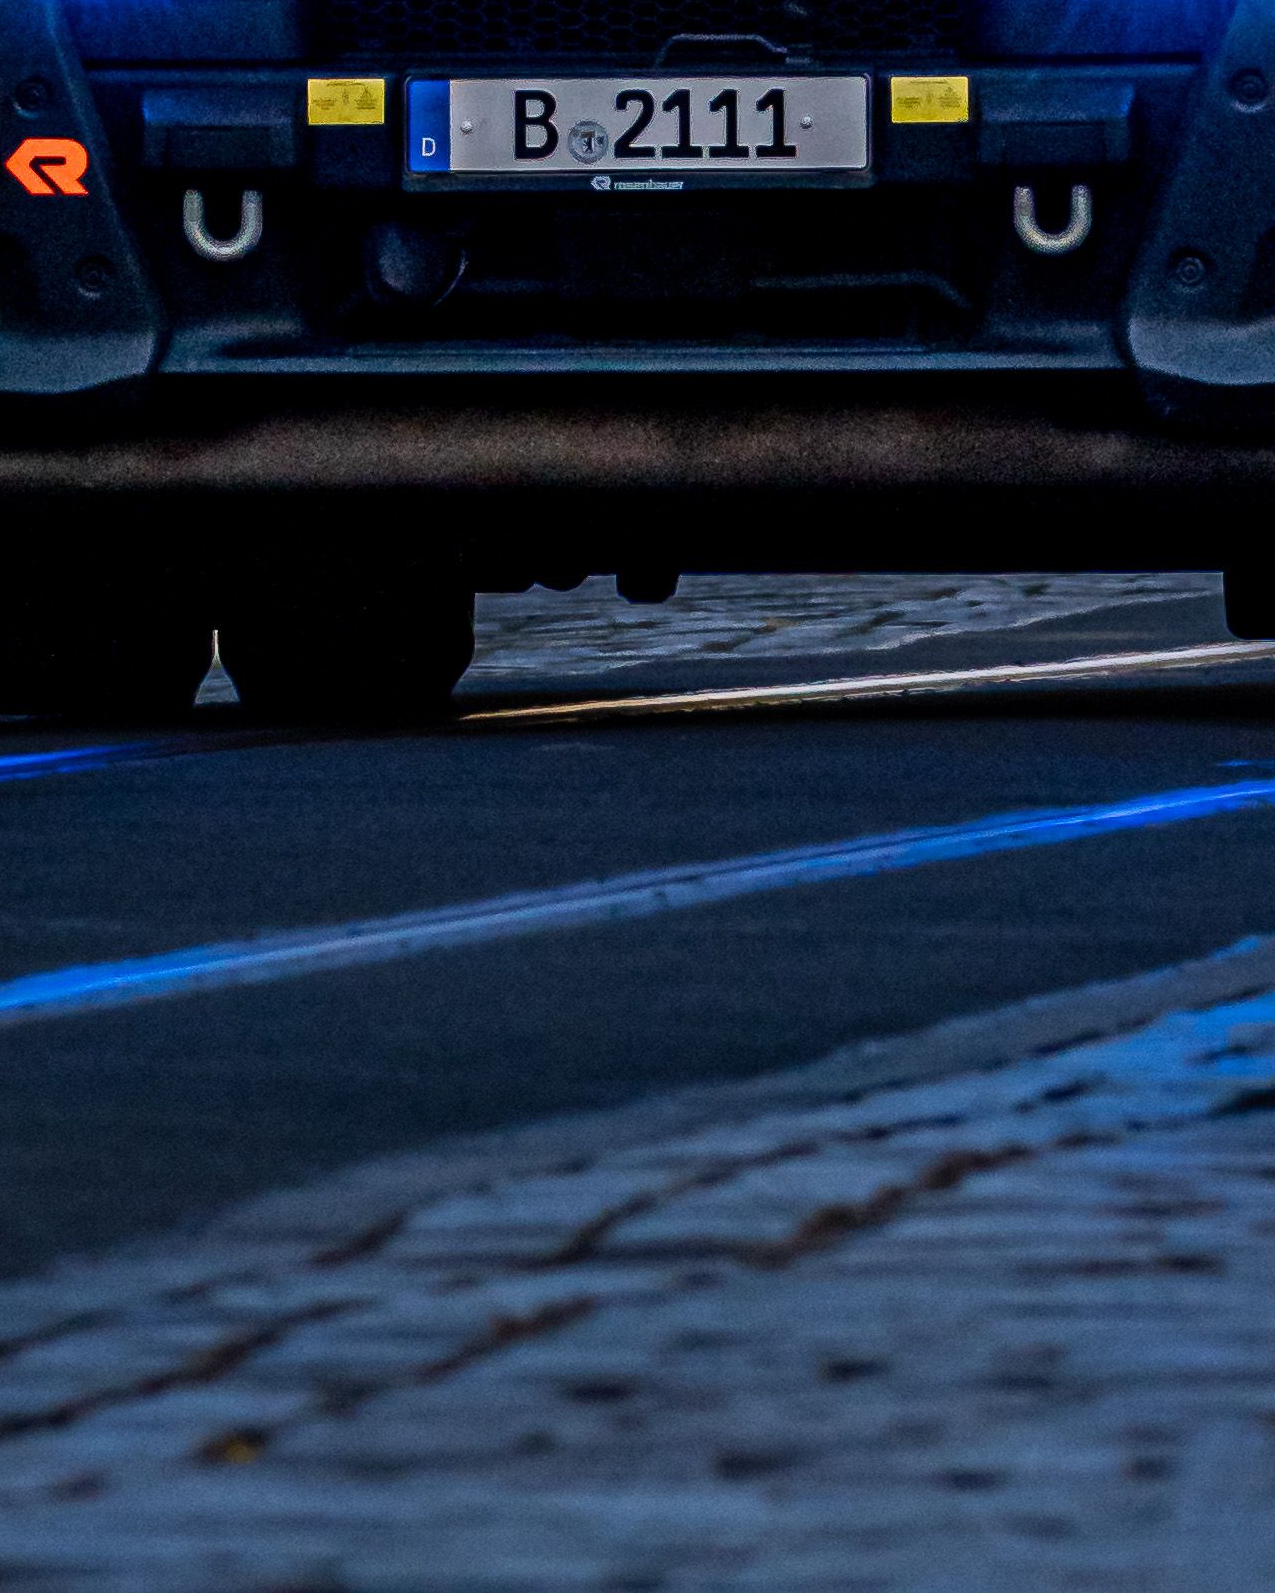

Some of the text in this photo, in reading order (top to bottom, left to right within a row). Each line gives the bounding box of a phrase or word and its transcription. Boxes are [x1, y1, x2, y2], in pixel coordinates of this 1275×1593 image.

[421, 137, 436, 157] D
[515, 88, 797, 160] B 2111
